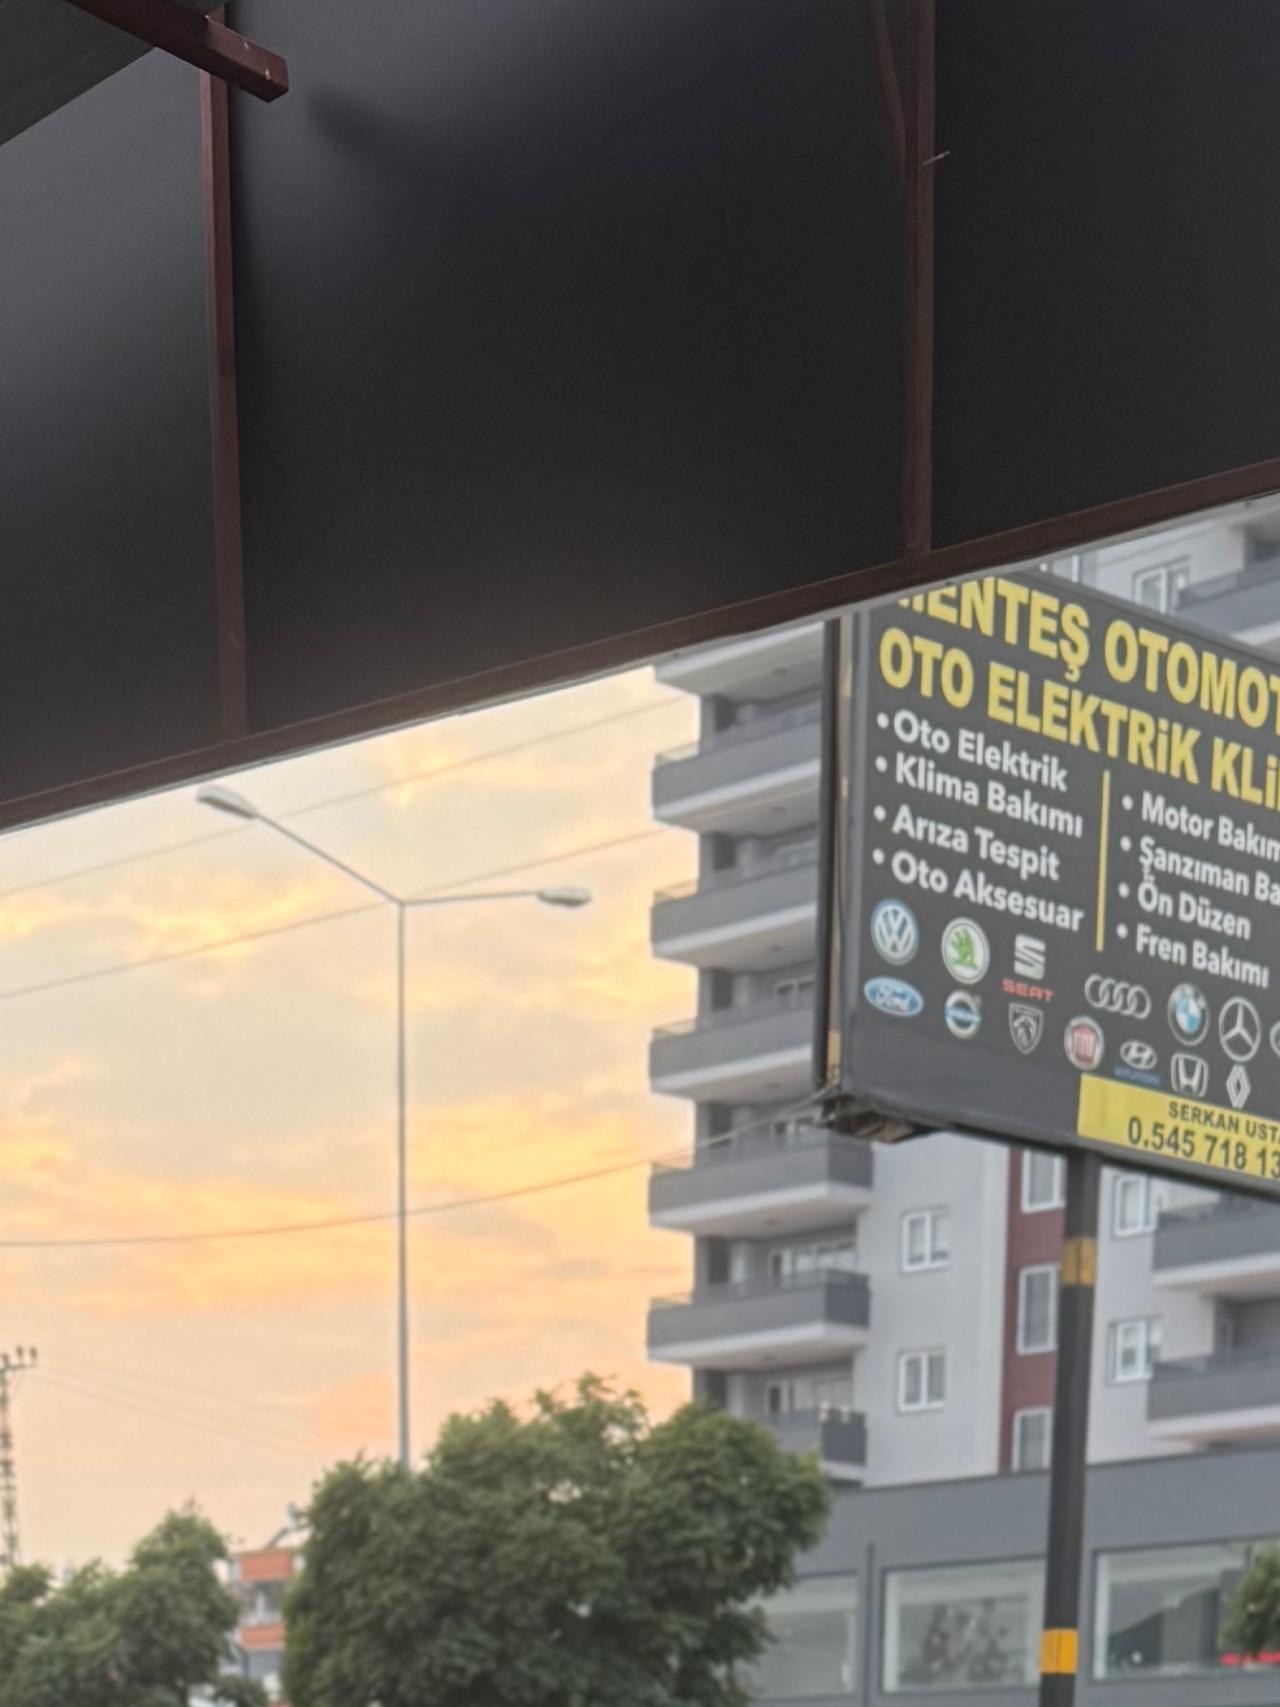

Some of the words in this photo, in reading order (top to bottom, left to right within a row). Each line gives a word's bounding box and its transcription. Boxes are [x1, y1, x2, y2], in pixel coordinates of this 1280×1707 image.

[879, 627, 974, 709] OTO
[893, 709, 950, 754] Oto
[957, 728, 1068, 792] Elektrik
[895, 751, 979, 807] Klima
[986, 779, 1083, 839] Bakımı
[1141, 791, 1214, 841] Motor
[891, 803, 969, 854] Arıza
[974, 826, 1060, 881] Tespit
[1138, 834, 1251, 896] Şanzıman
[891, 849, 948, 894] Oto
[953, 868, 1085, 932] Aksesuar
[1137, 874, 1173, 918] Ön
[1178, 891, 1251, 941] Düzen
[1136, 923, 1188, 967] Fren
[1192, 938, 1270, 989] Bakımı
[1002, 978, 1054, 1002] SEAT
[1127, 1116, 1196, 1159] 0.545
[1204, 1133, 1247, 1170] 718
[1168, 1100, 1240, 1134] SERKAN
